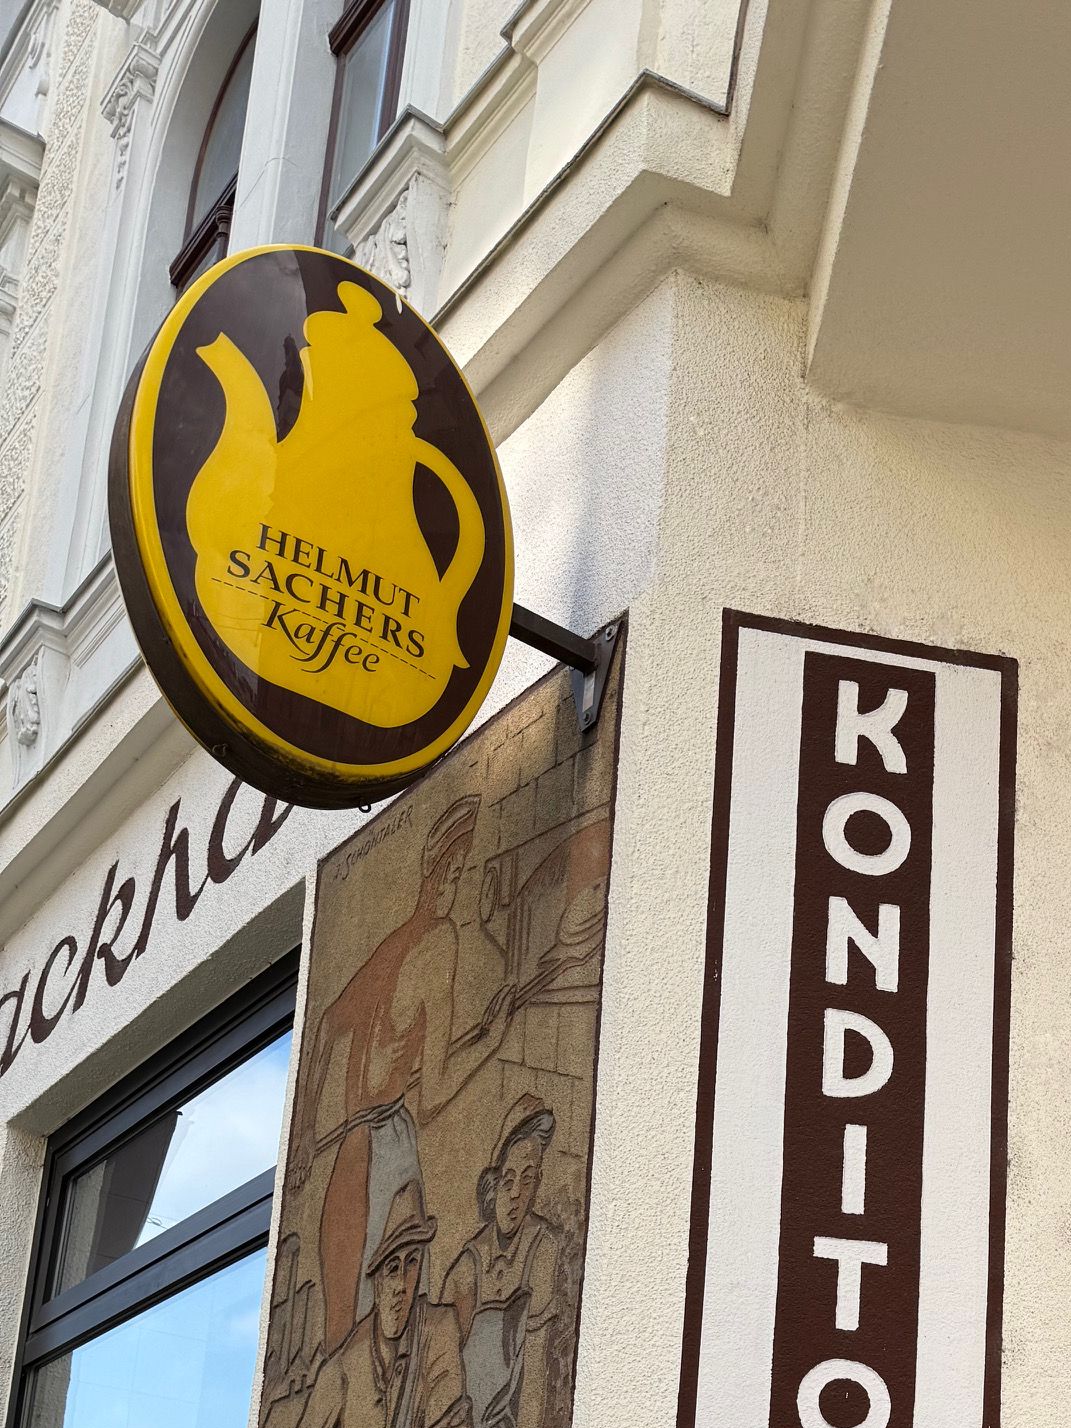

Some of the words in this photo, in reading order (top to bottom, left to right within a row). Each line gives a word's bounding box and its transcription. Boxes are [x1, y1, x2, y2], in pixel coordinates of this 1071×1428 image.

[227, 549, 424, 658] SACHERS
[256, 522, 420, 618] HELMUT
[261, 600, 380, 673] Kaffee
